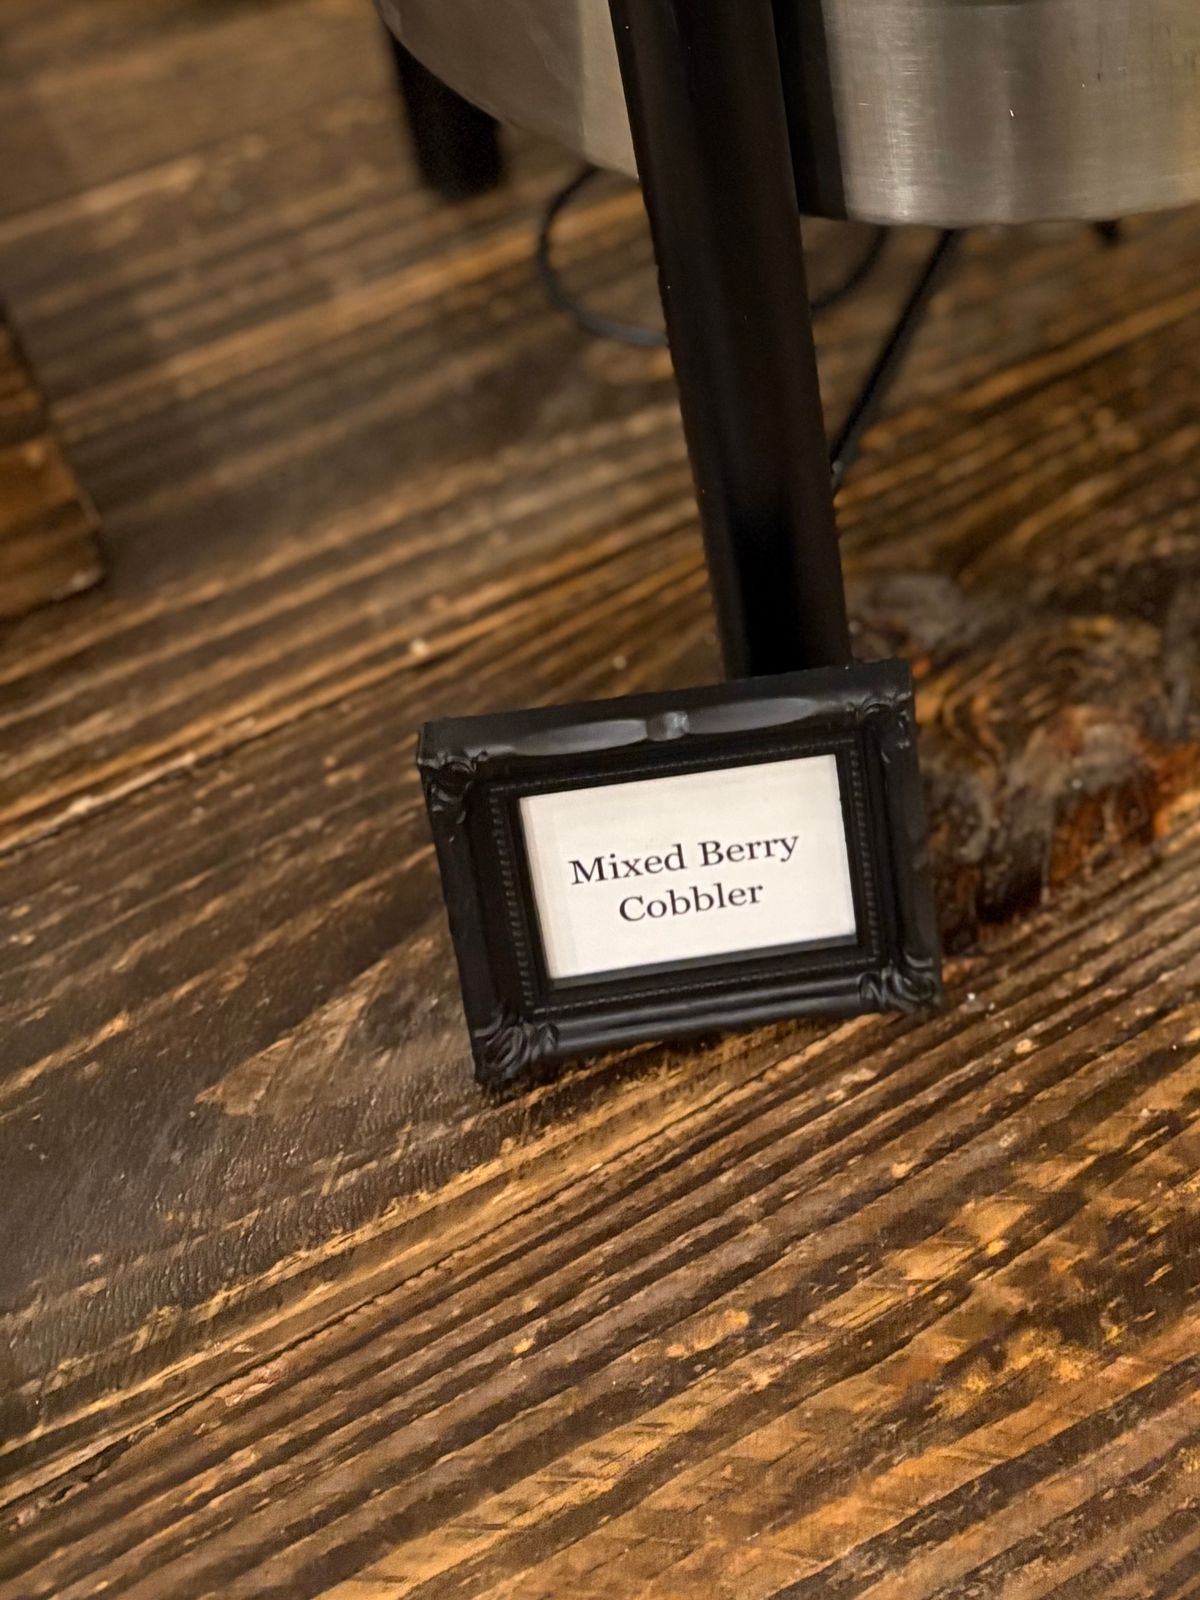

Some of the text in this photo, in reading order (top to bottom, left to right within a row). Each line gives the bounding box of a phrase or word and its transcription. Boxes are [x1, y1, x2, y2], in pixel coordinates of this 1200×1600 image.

[568, 834, 800, 886] Mixed Berry
[618, 882, 764, 923] Cobbler
